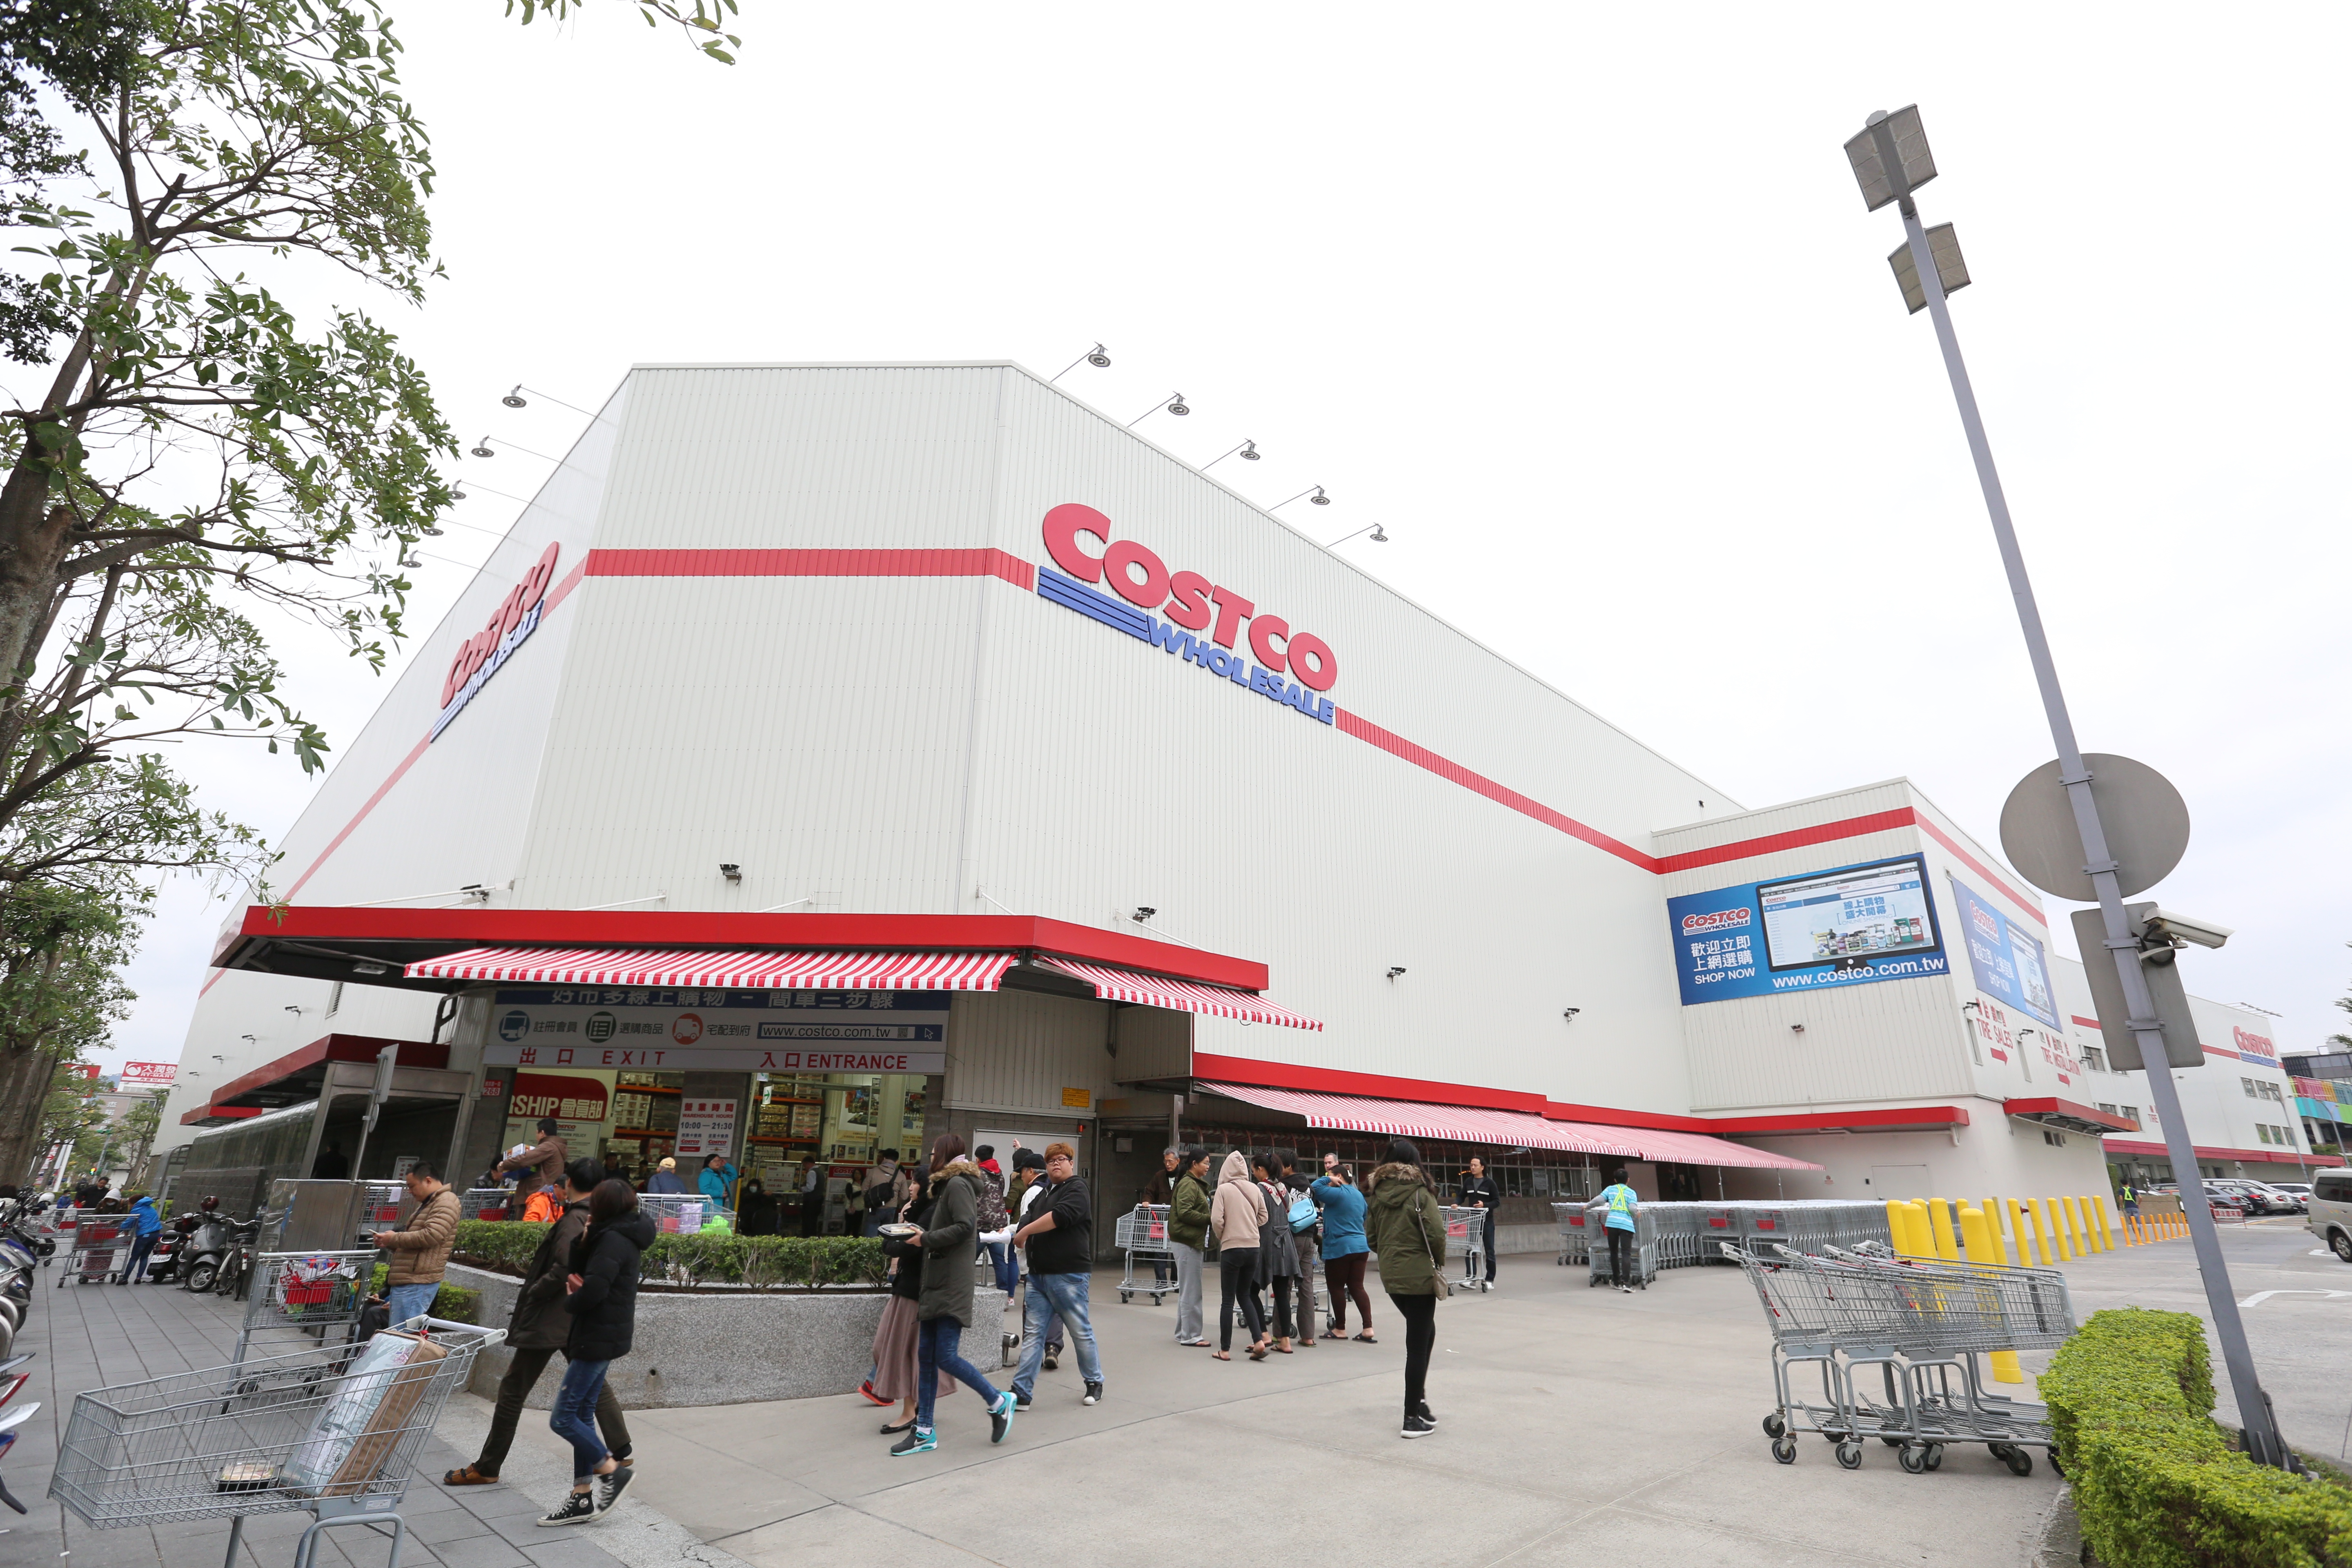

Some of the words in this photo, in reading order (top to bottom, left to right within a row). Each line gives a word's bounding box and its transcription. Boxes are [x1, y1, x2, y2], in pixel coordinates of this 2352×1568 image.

[1042, 503, 1337, 691] COSTCO
[441, 541, 559, 709] COSTCO
[1146, 615, 1335, 725] WHOLESALE
[1843, 896, 1885, 910] 線上購物
[1845, 905, 1886, 919] 盛大開幕
[1682, 907, 1750, 929] COSTCO
[1704, 919, 1750, 932] WHOLESALE
[1863, 913, 1893, 922] SHOPPING
[1969, 900, 1998, 935] COSTCO
[1690, 935, 1751, 957] 歡迎立即
[1693, 951, 1753, 972] 上網選購
[1695, 972, 1726, 985] SHOP
[1728, 967, 1755, 982] NOW
[1772, 956, 1944, 988] www.costco.com.tw
[533, 1021, 578, 1033] 註冊會員
[619, 1022, 664, 1035] 選購商品
[706, 1024, 751, 1036] 宅配到府
[763, 1026, 891, 1038] www.costco.com.tw
[1976, 1017, 1993, 1041] TIRE
[1993, 1025, 2013, 1049] SALES
[2233, 1025, 2274, 1058] COSTCO
[519, 1047, 574, 1065] 出口
[601, 1050, 666, 1065] EXIT
[760, 1052, 801, 1068] 入口
[807, 1054, 908, 1069] ENTRANCE
[142, 1064, 177, 1074] 大潤發
[559, 1098, 604, 1119] 會員部
